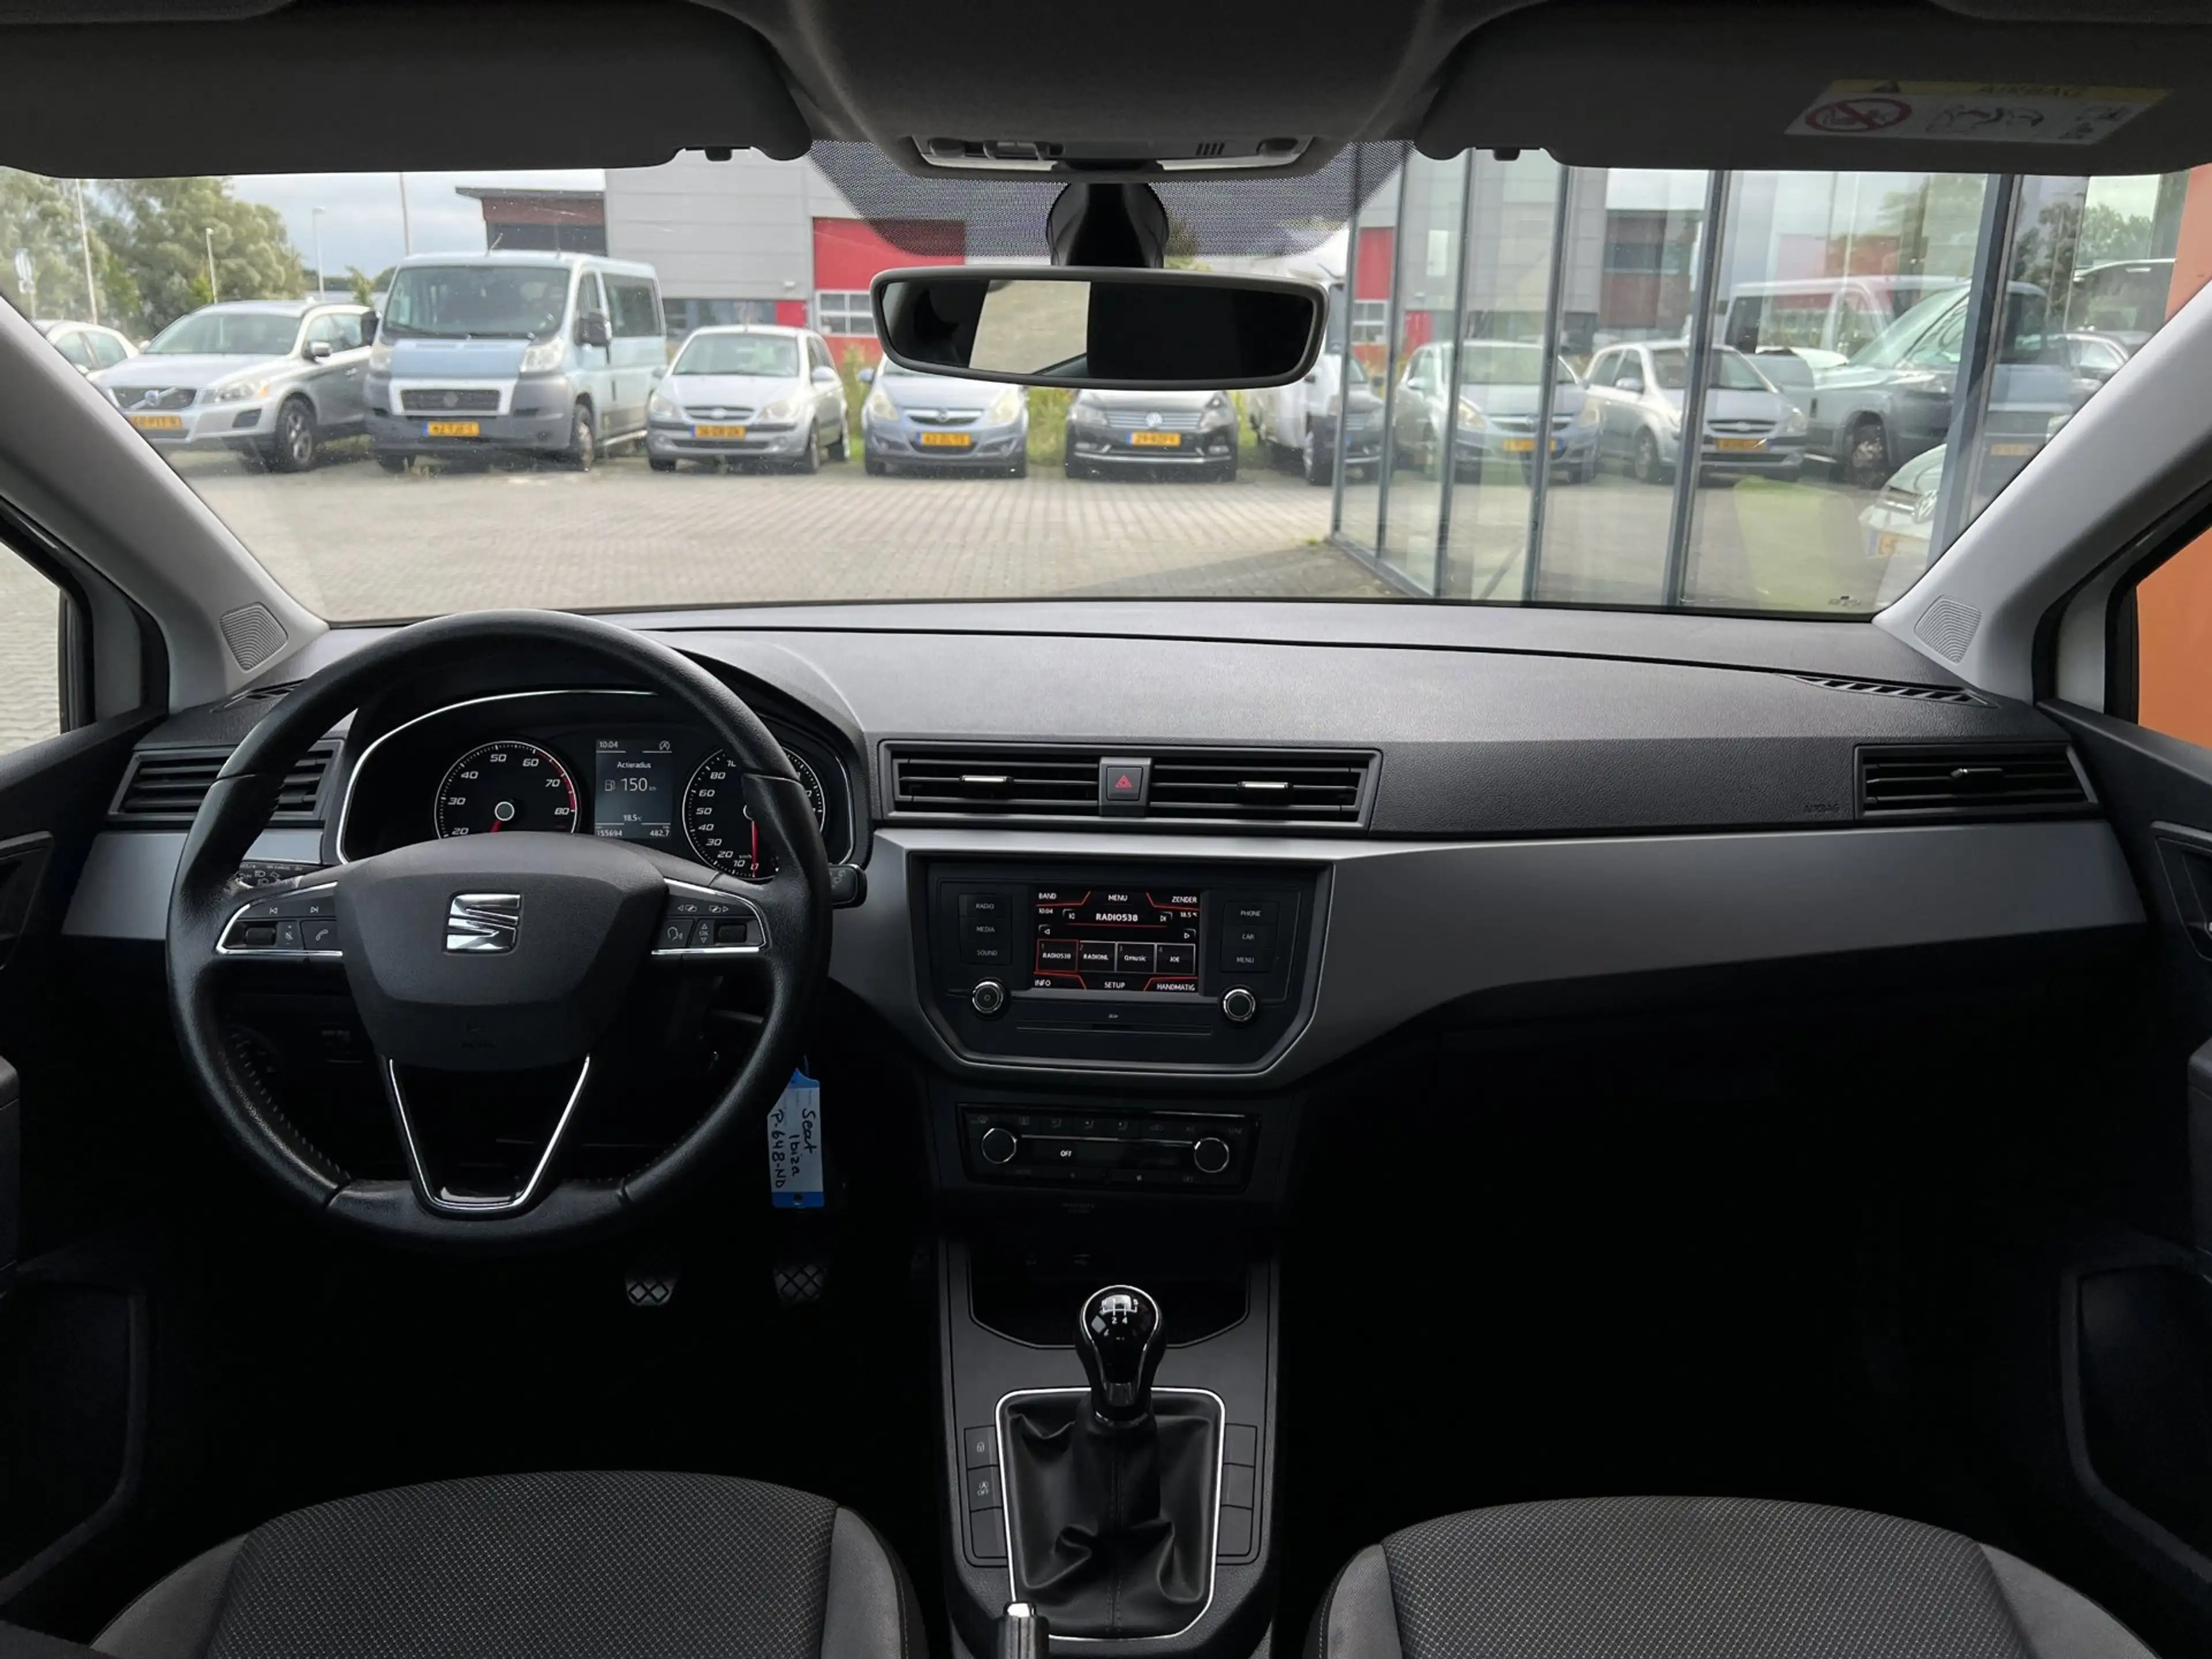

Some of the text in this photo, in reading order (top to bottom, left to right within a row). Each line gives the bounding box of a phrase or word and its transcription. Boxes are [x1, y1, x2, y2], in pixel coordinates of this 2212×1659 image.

[490, 754, 507, 762] 50
[522, 759, 539, 767] 60
[461, 771, 478, 779] 40
[545, 779, 560, 787] 70
[621, 778, 648, 791] 150
[699, 789, 715, 797] 60
[1096, 913, 1138, 922] RADIO538
[802, 1108, 817, 1154] Seat
